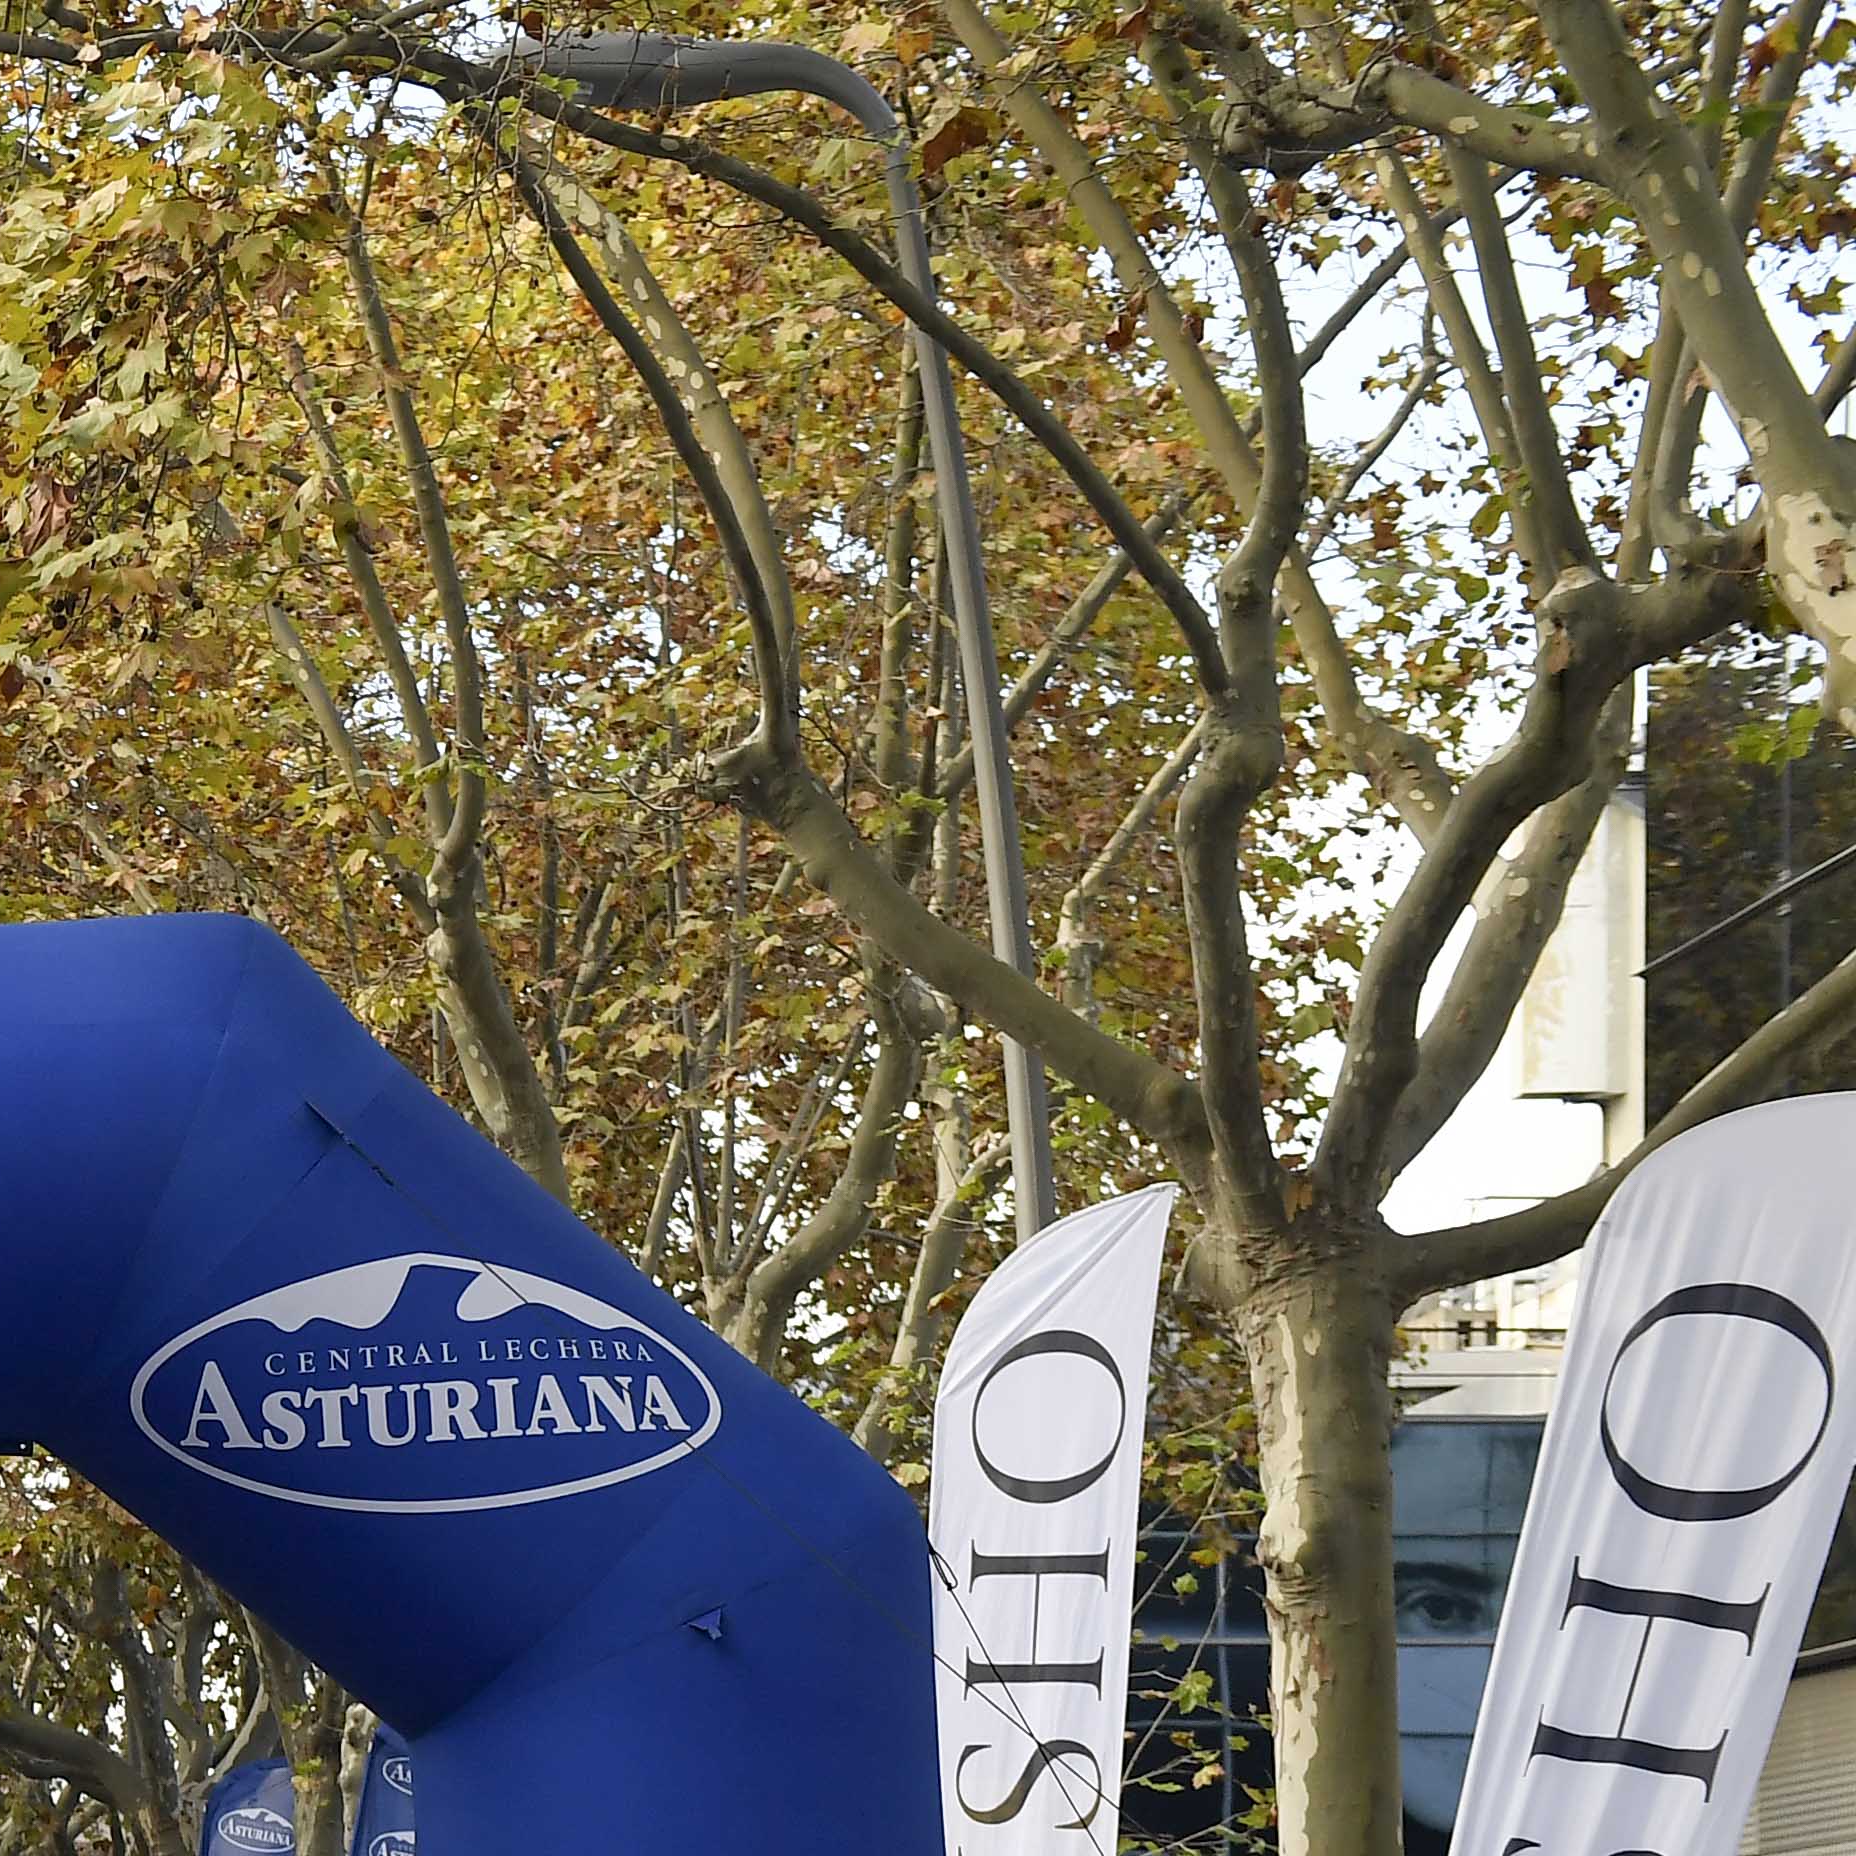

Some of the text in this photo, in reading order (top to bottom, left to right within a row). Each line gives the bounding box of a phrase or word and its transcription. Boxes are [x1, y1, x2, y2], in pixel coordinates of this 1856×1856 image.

[264, 1337, 655, 1377] CENTRAL LECHERA
[180, 1360, 692, 1451] ASTURIANA
[224, 1817, 291, 1845] ASTURIANA
